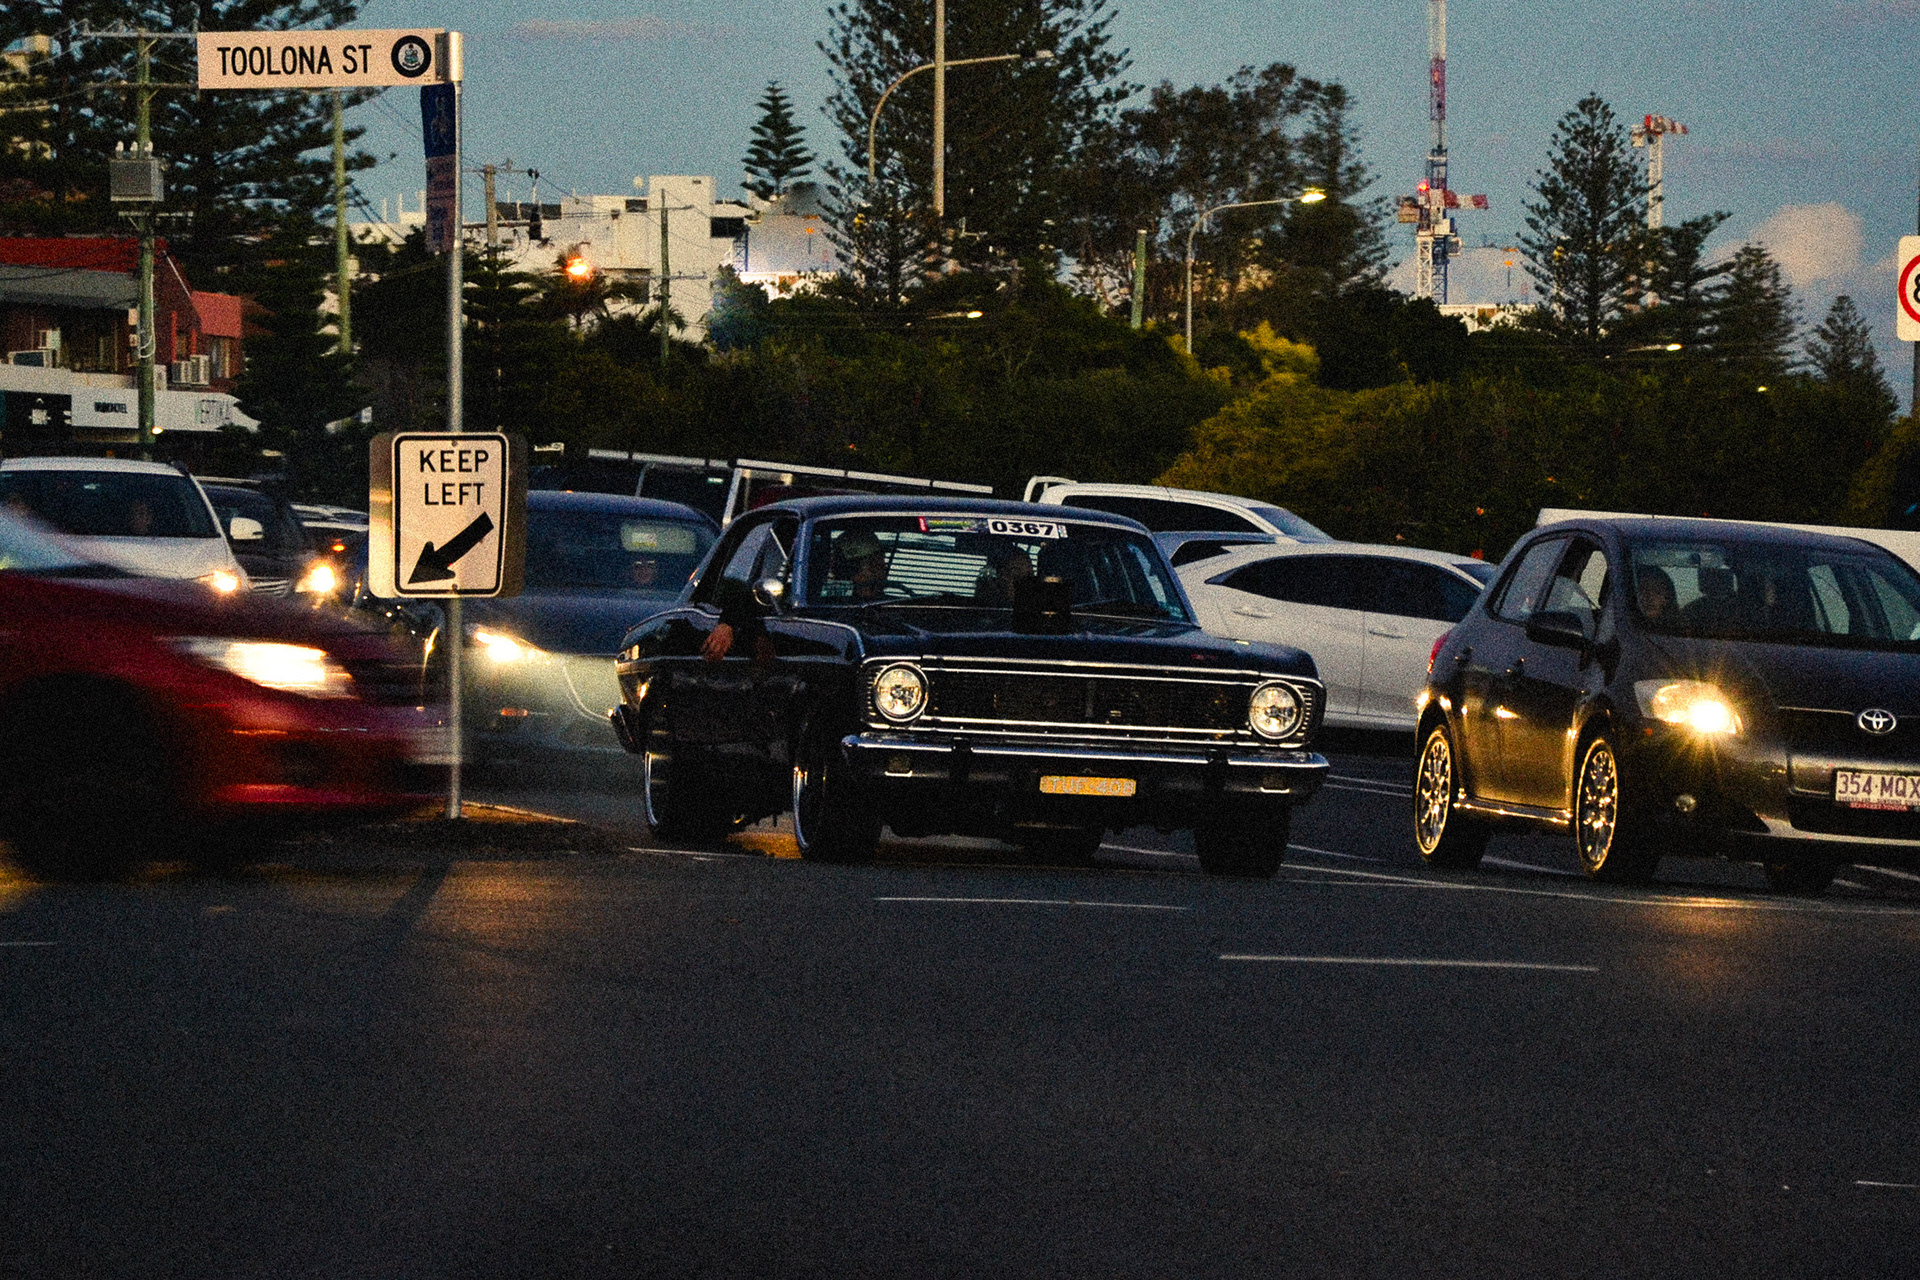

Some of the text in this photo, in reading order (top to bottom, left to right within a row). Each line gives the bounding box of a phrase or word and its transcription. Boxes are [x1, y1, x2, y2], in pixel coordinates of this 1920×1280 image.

[217, 45, 372, 76] TOOLONA ST
[419, 449, 489, 473] KEEP
[424, 482, 485, 506] LEFT
[991, 520, 1054, 536] 0367
